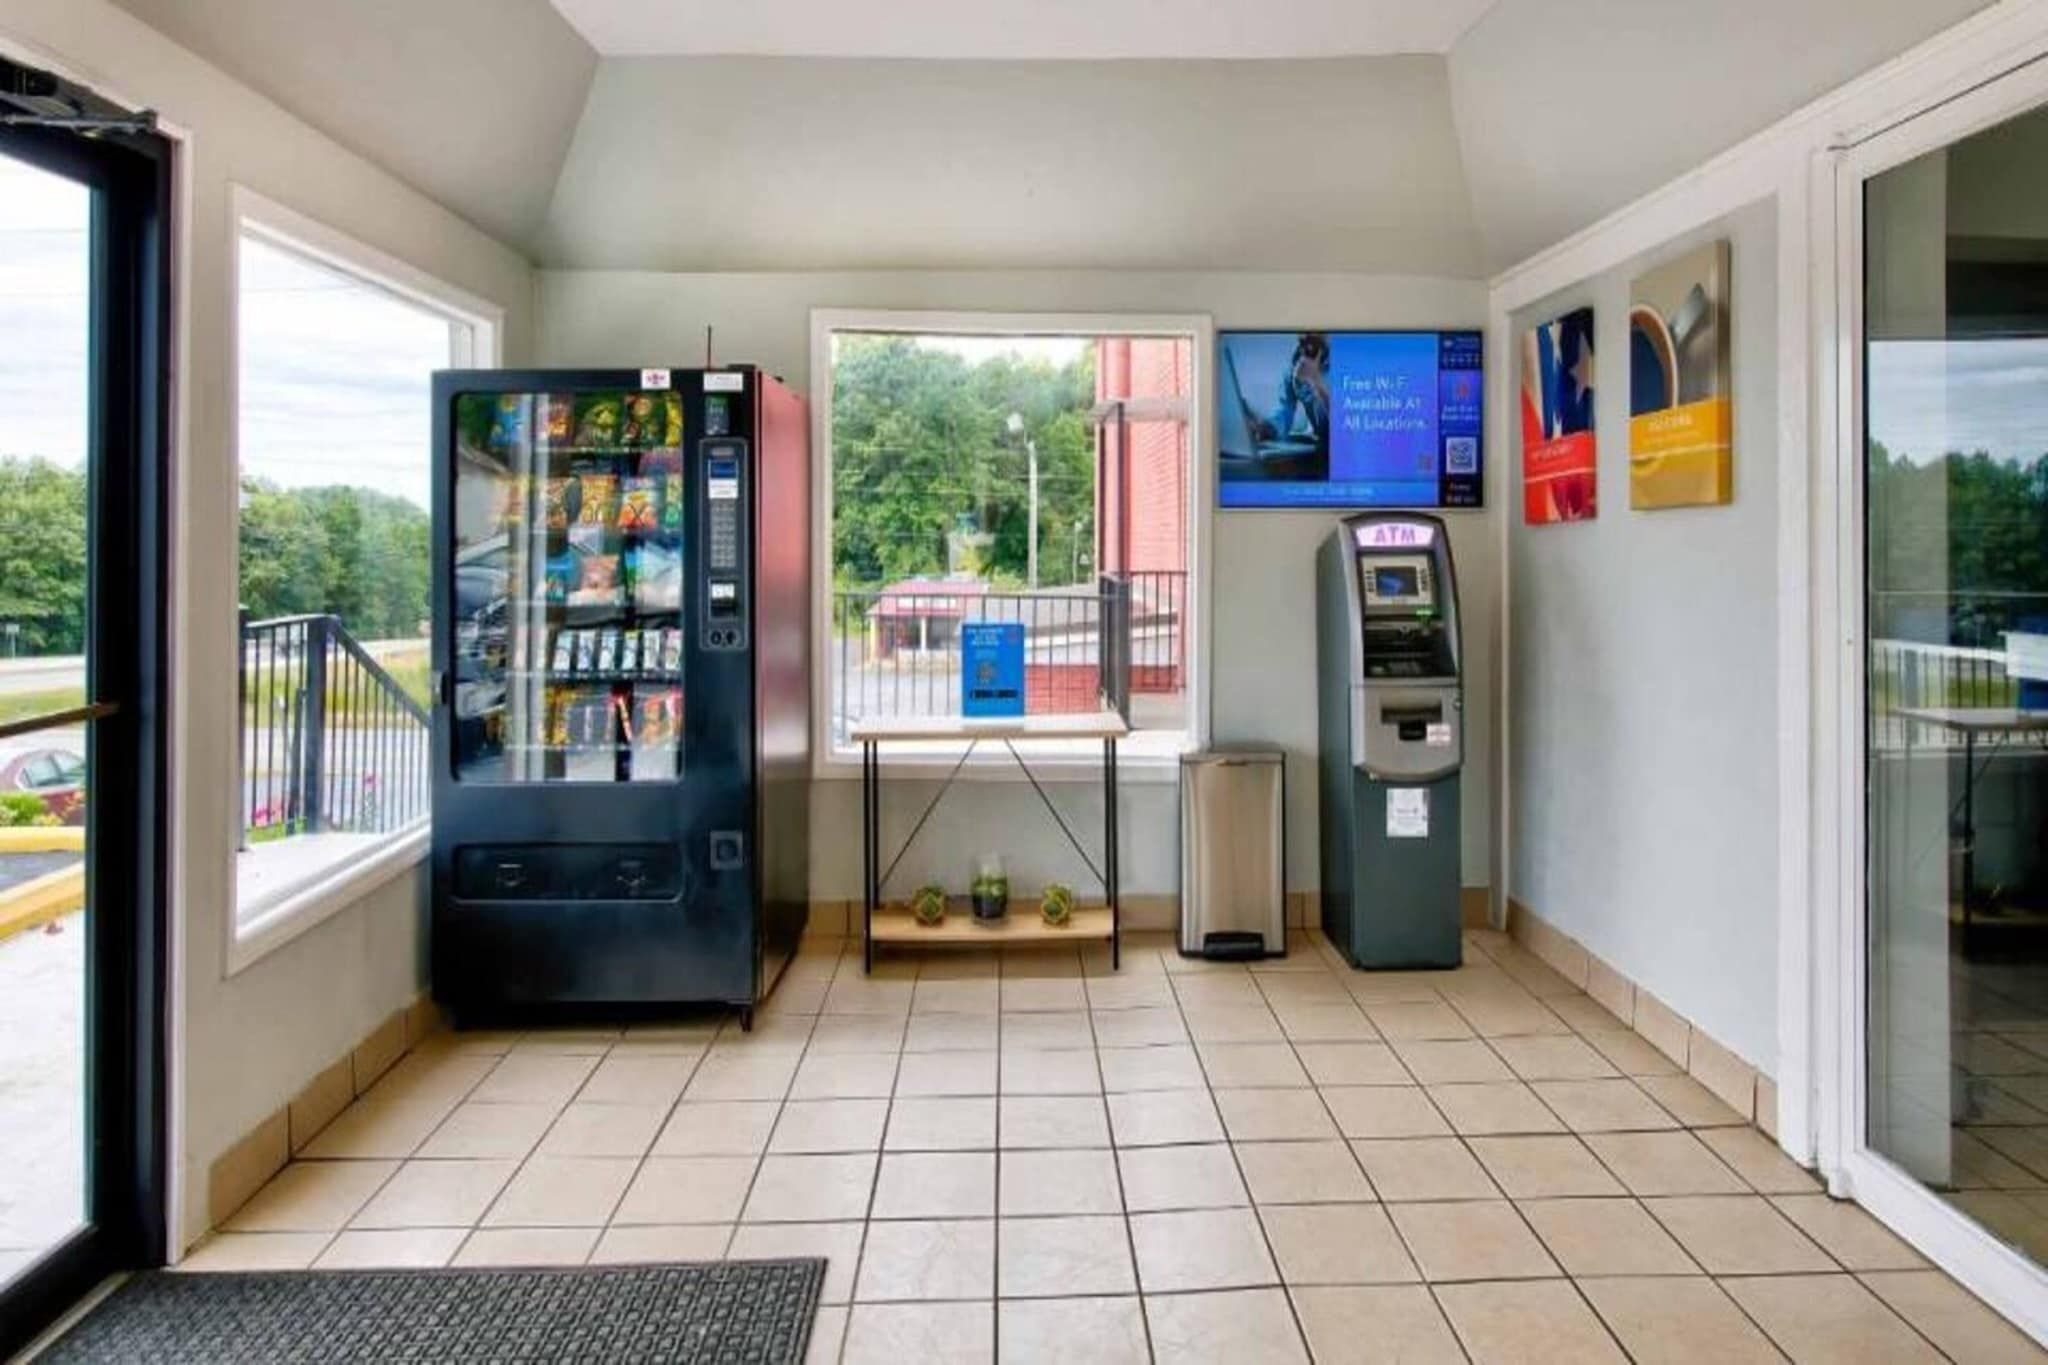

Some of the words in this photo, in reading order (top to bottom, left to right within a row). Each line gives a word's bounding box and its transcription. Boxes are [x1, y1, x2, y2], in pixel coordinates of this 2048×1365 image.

[1343, 375, 1371, 391] Free
[1344, 414, 1361, 430] All
[1375, 525, 1416, 543] ATM
